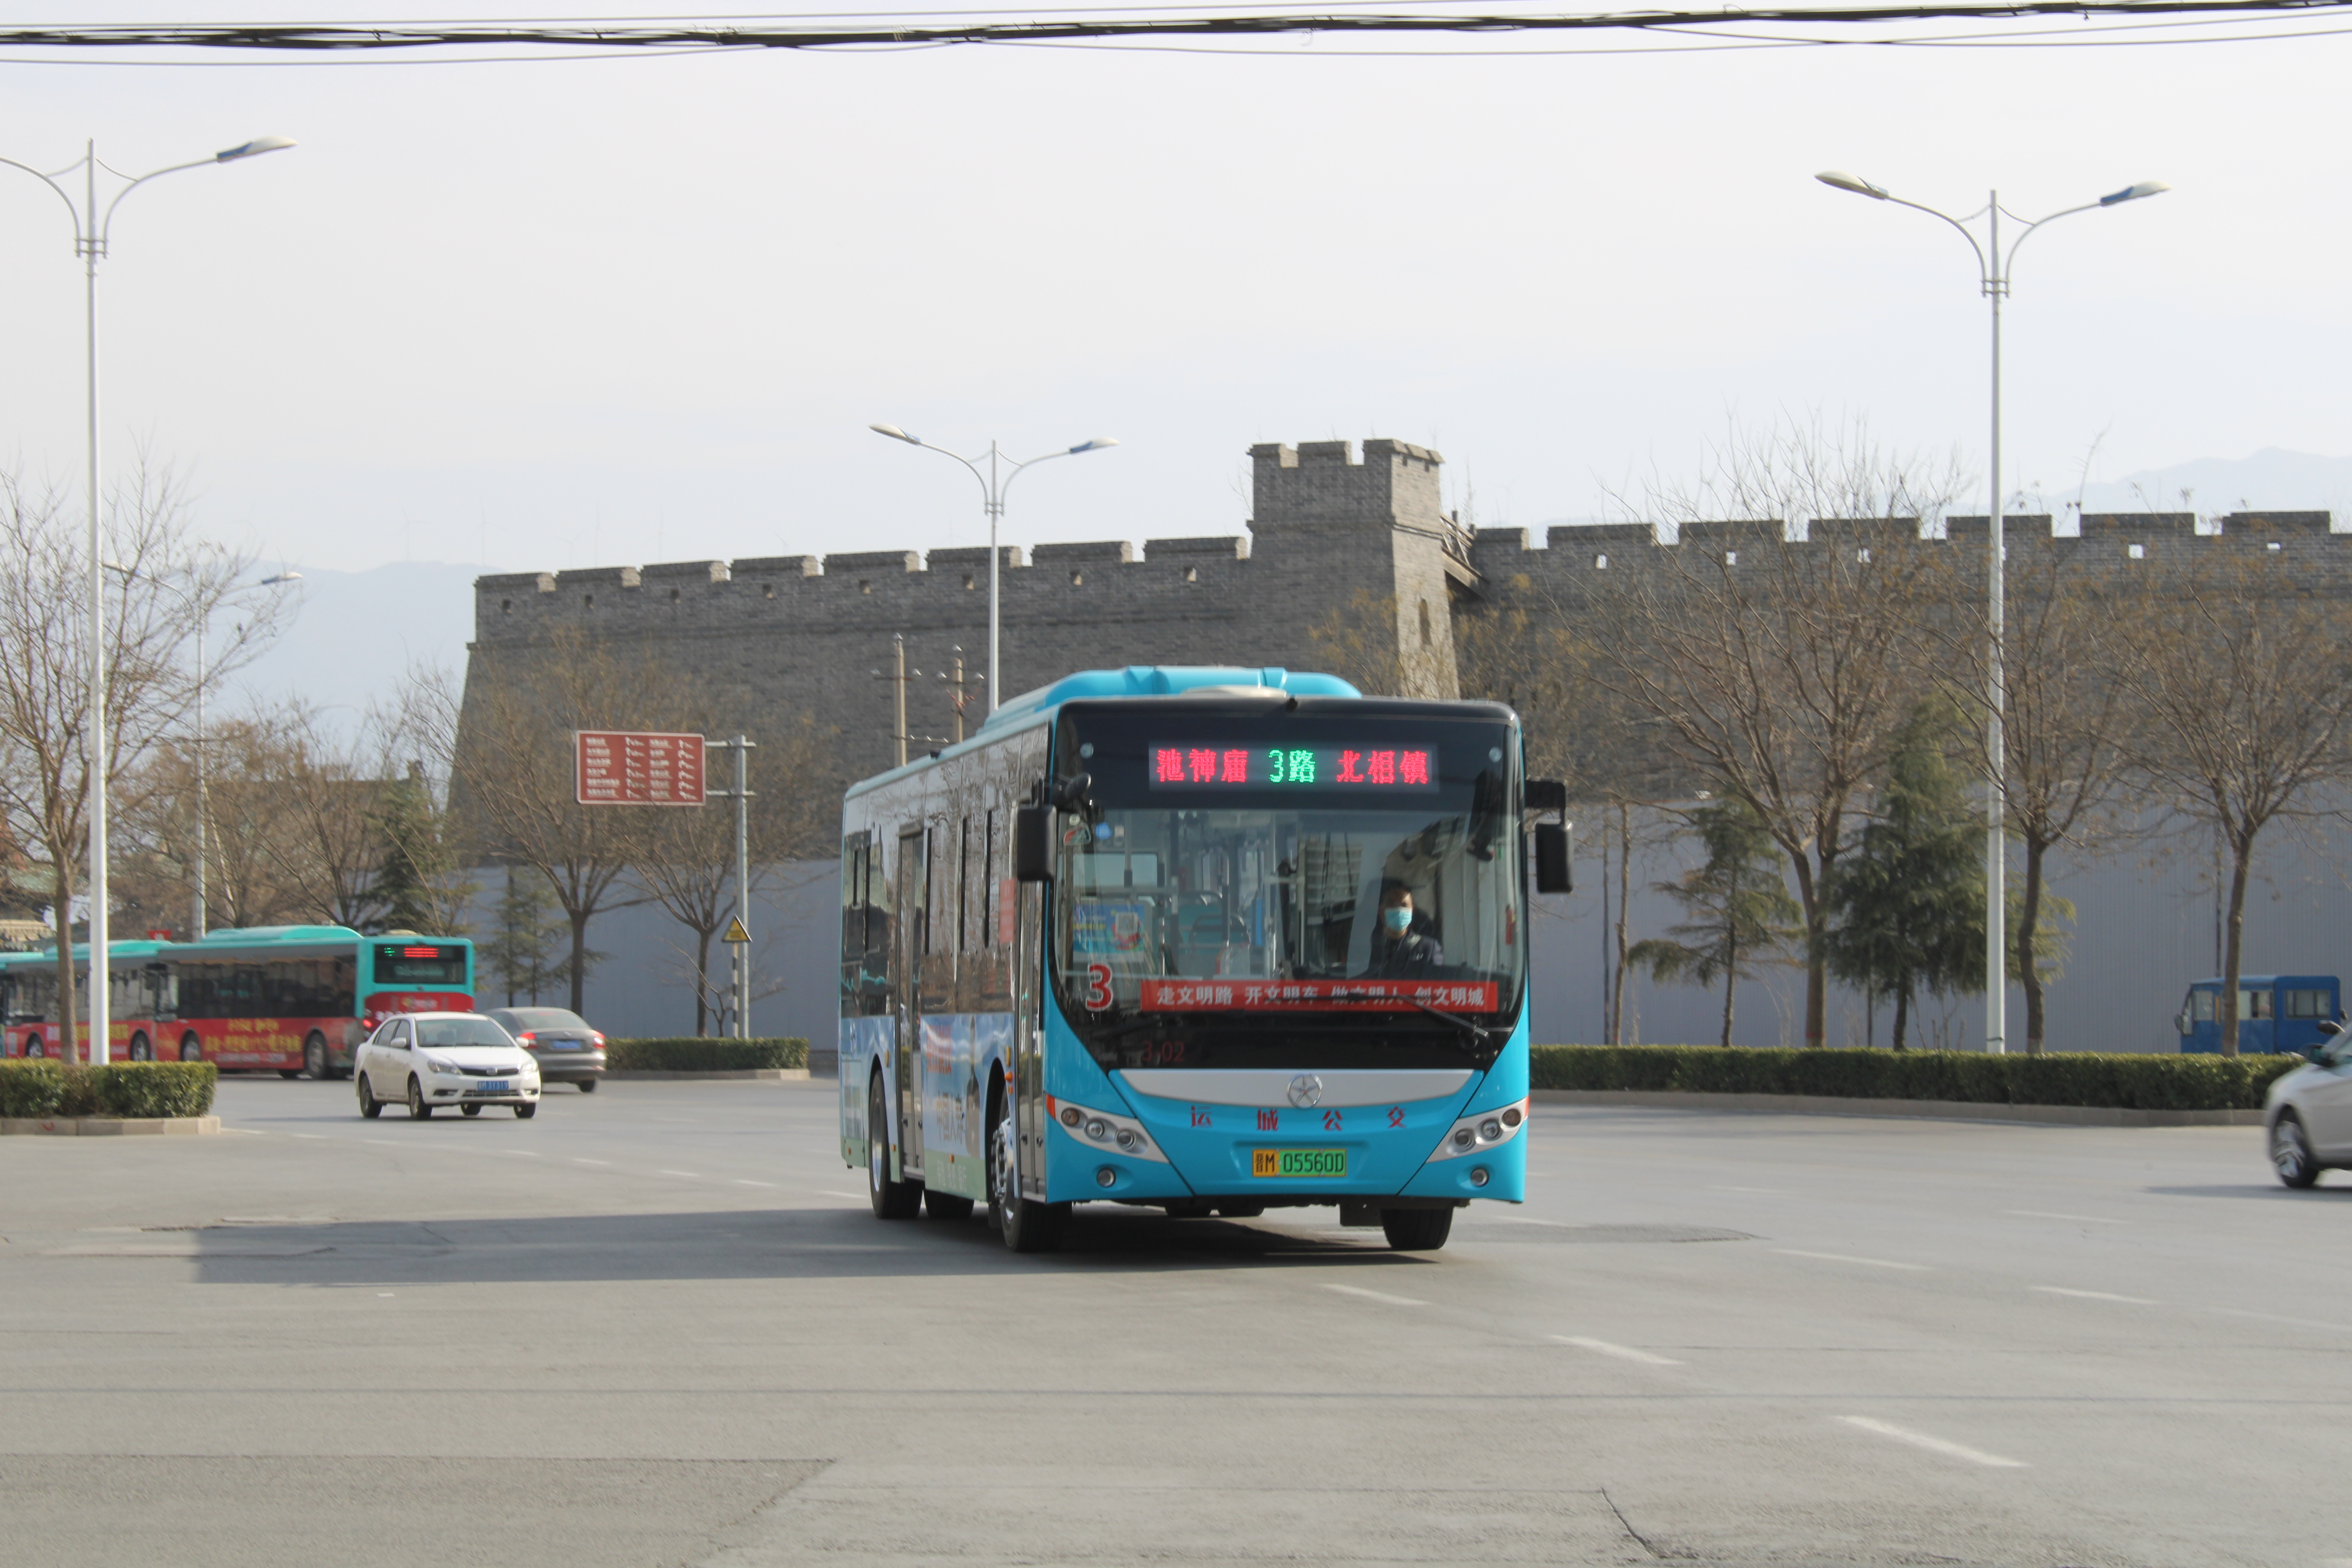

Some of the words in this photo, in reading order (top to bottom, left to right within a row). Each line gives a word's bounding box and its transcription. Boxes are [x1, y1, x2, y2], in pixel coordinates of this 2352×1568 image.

[1267, 748, 1317, 783] 3路
[1086, 963, 1113, 1010] 3
[1157, 985, 1233, 1005] 走文明路
